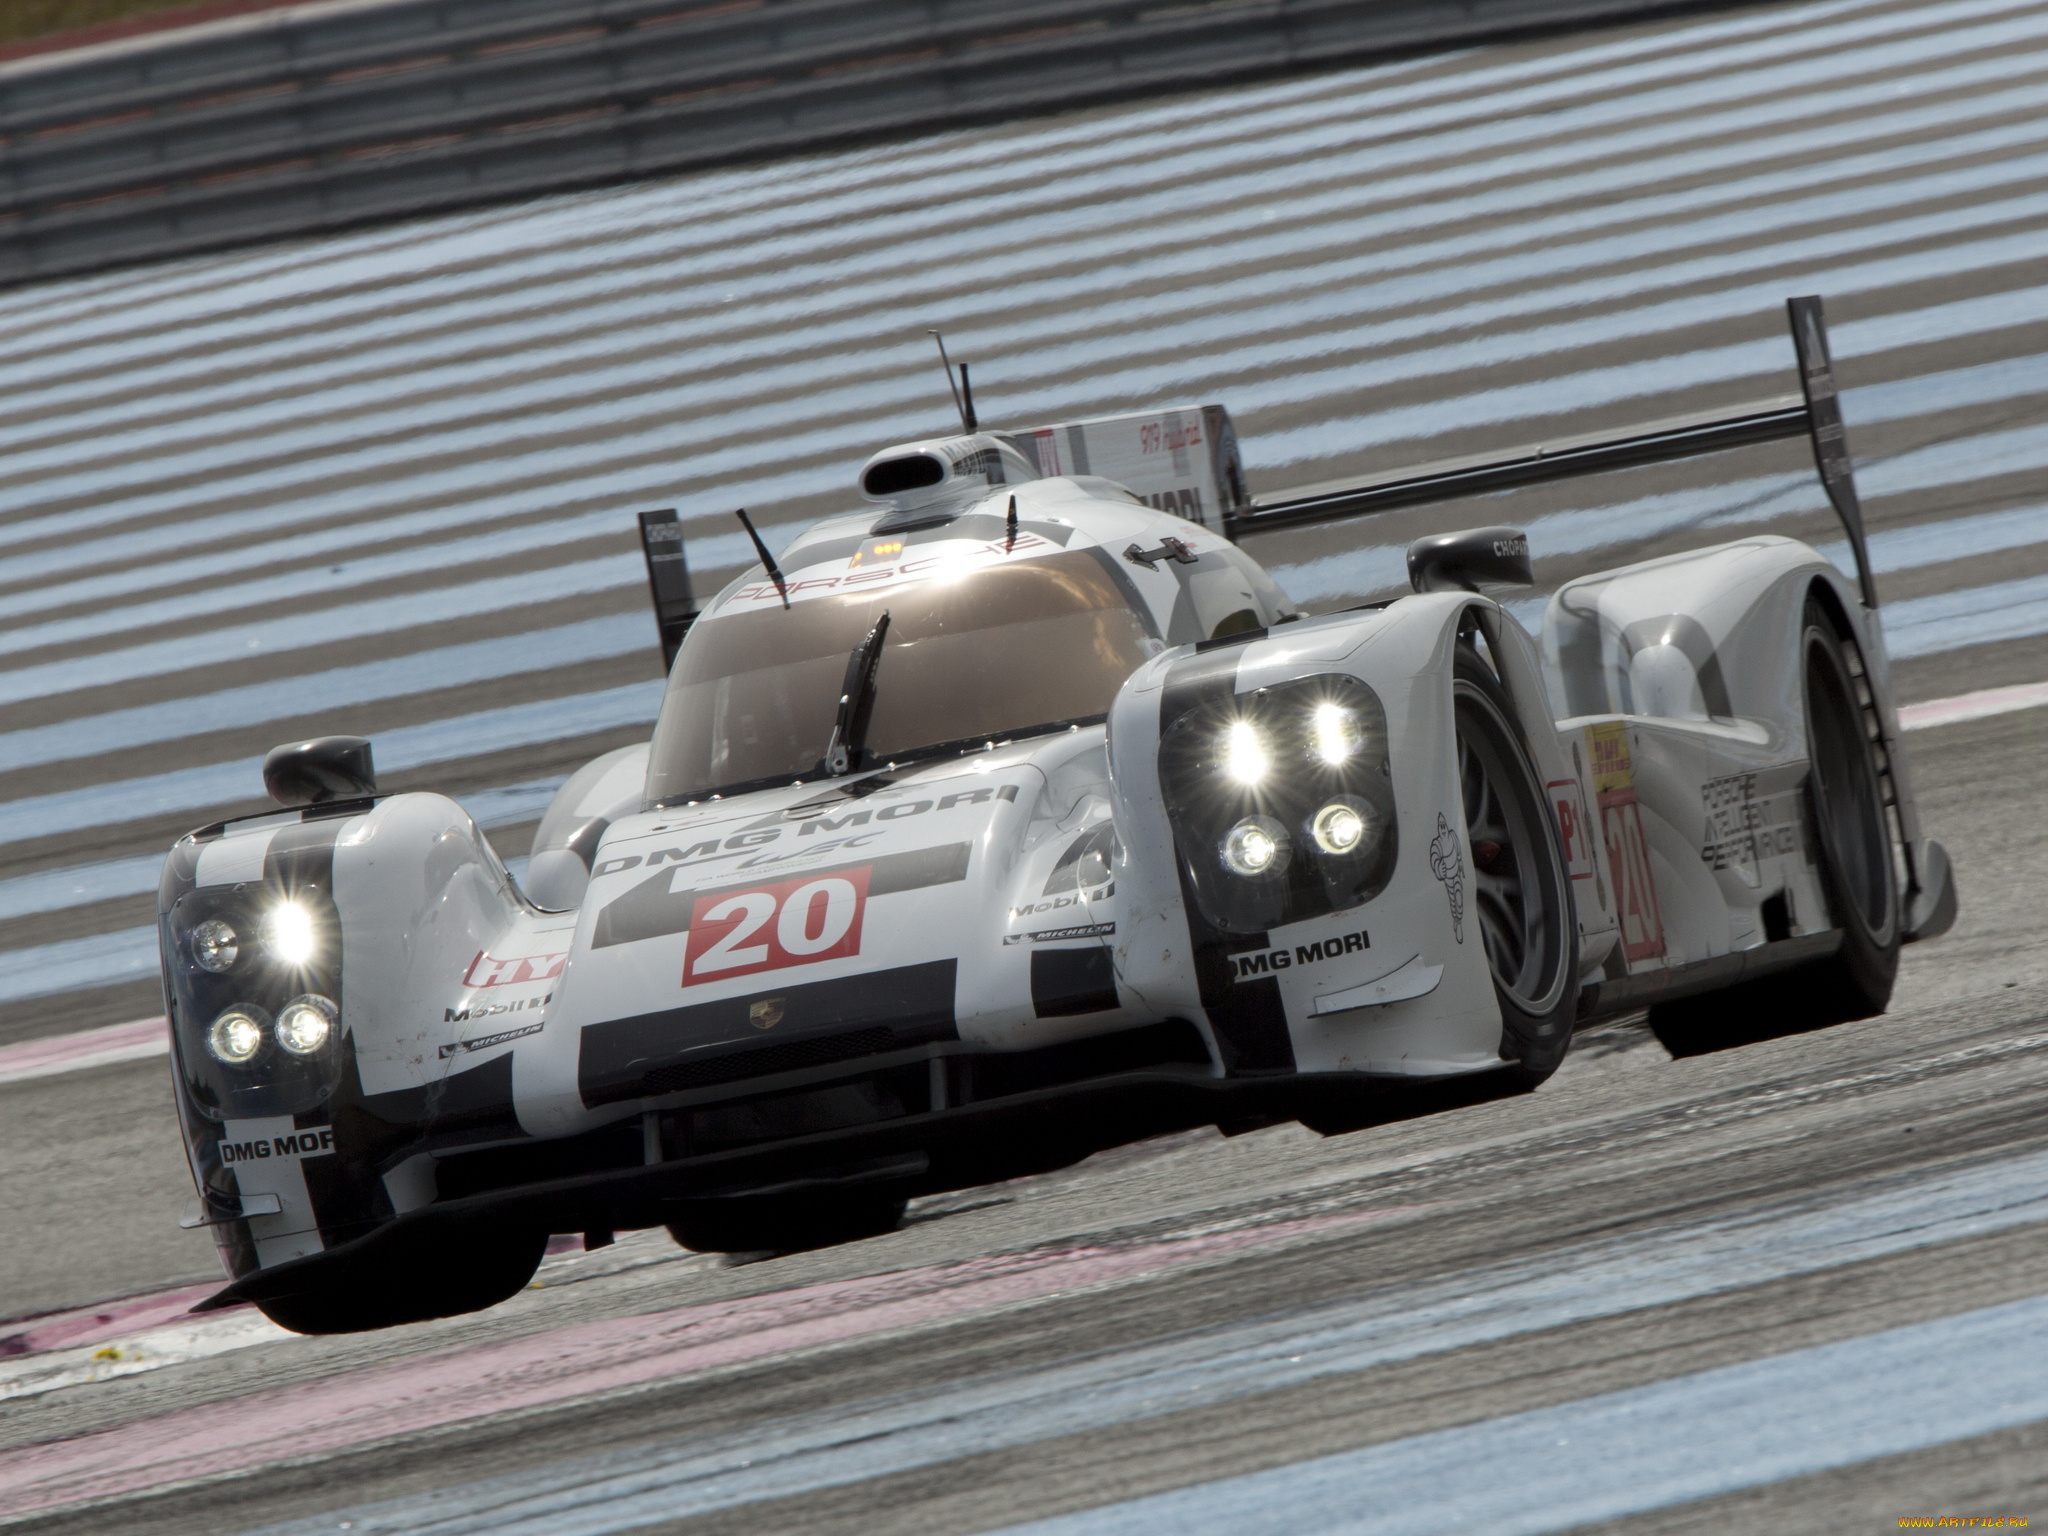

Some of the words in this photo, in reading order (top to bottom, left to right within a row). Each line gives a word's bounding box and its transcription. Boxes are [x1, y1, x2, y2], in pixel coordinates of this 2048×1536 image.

[589, 828, 783, 884] DMG
[797, 784, 1020, 837] MORI
[1556, 799, 1587, 862] P1
[1605, 802, 1659, 945] 20
[1008, 890, 1087, 918] Mobi
[692, 877, 857, 976] 20
[1036, 923, 1114, 940] MICHELIN
[1295, 929, 1372, 966] MORI
[443, 1000, 525, 1023] Mobil
[470, 1023, 543, 1049] MICHELIN
[221, 1139, 272, 1163] DMG
